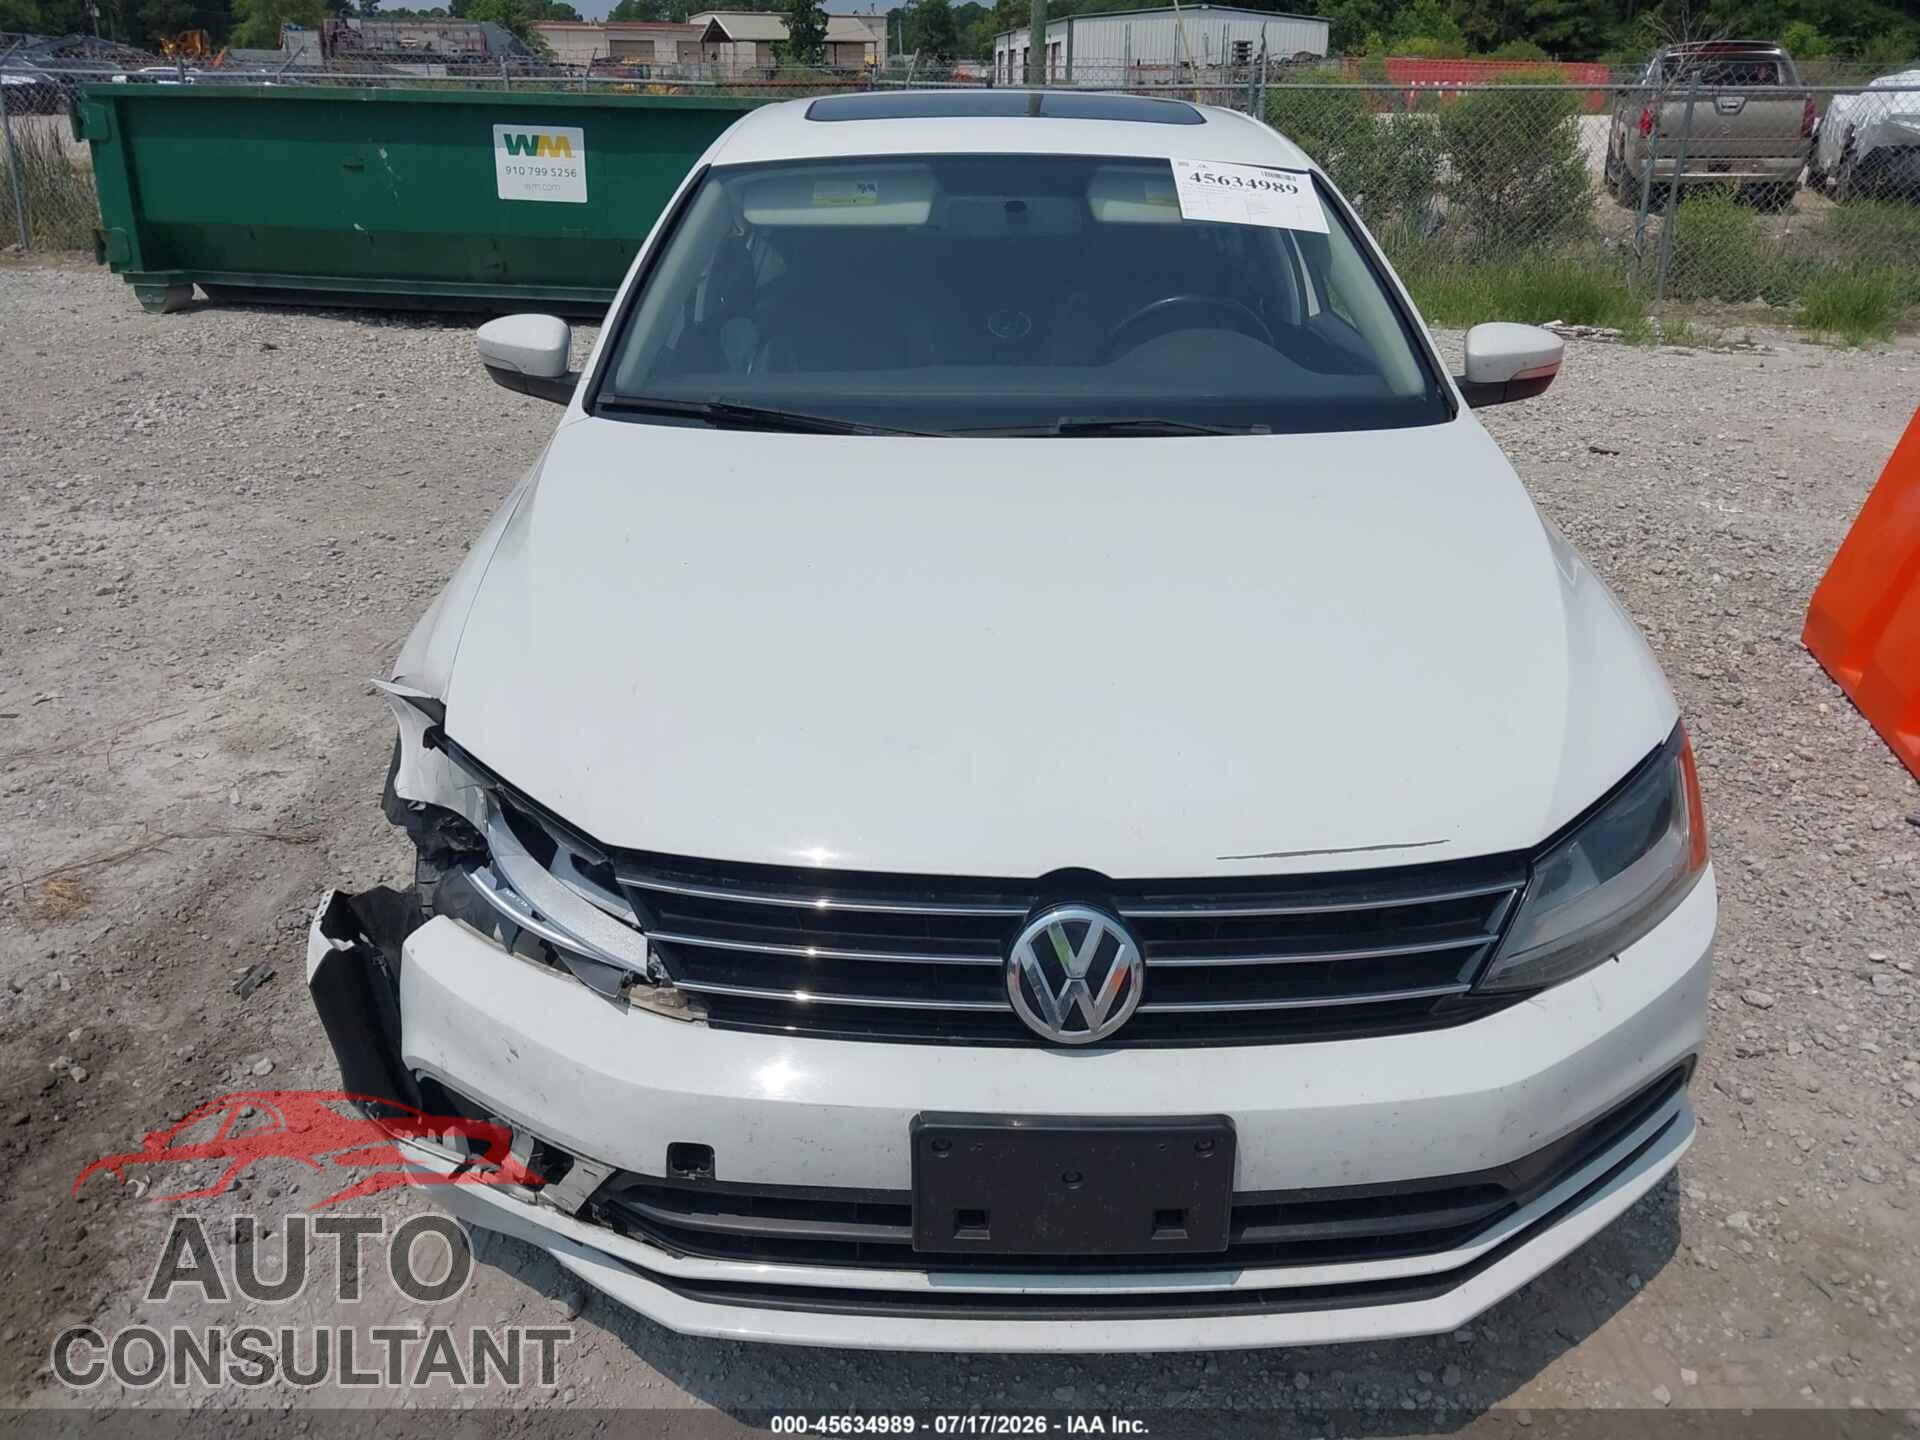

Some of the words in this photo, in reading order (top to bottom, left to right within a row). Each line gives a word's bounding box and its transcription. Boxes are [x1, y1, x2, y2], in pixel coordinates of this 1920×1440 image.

[503, 133, 572, 158] WM
[505, 166, 525, 176] 910
[527, 166, 548, 177] 799
[550, 167, 577, 178] 5256
[1190, 171, 1299, 195] 45634989
